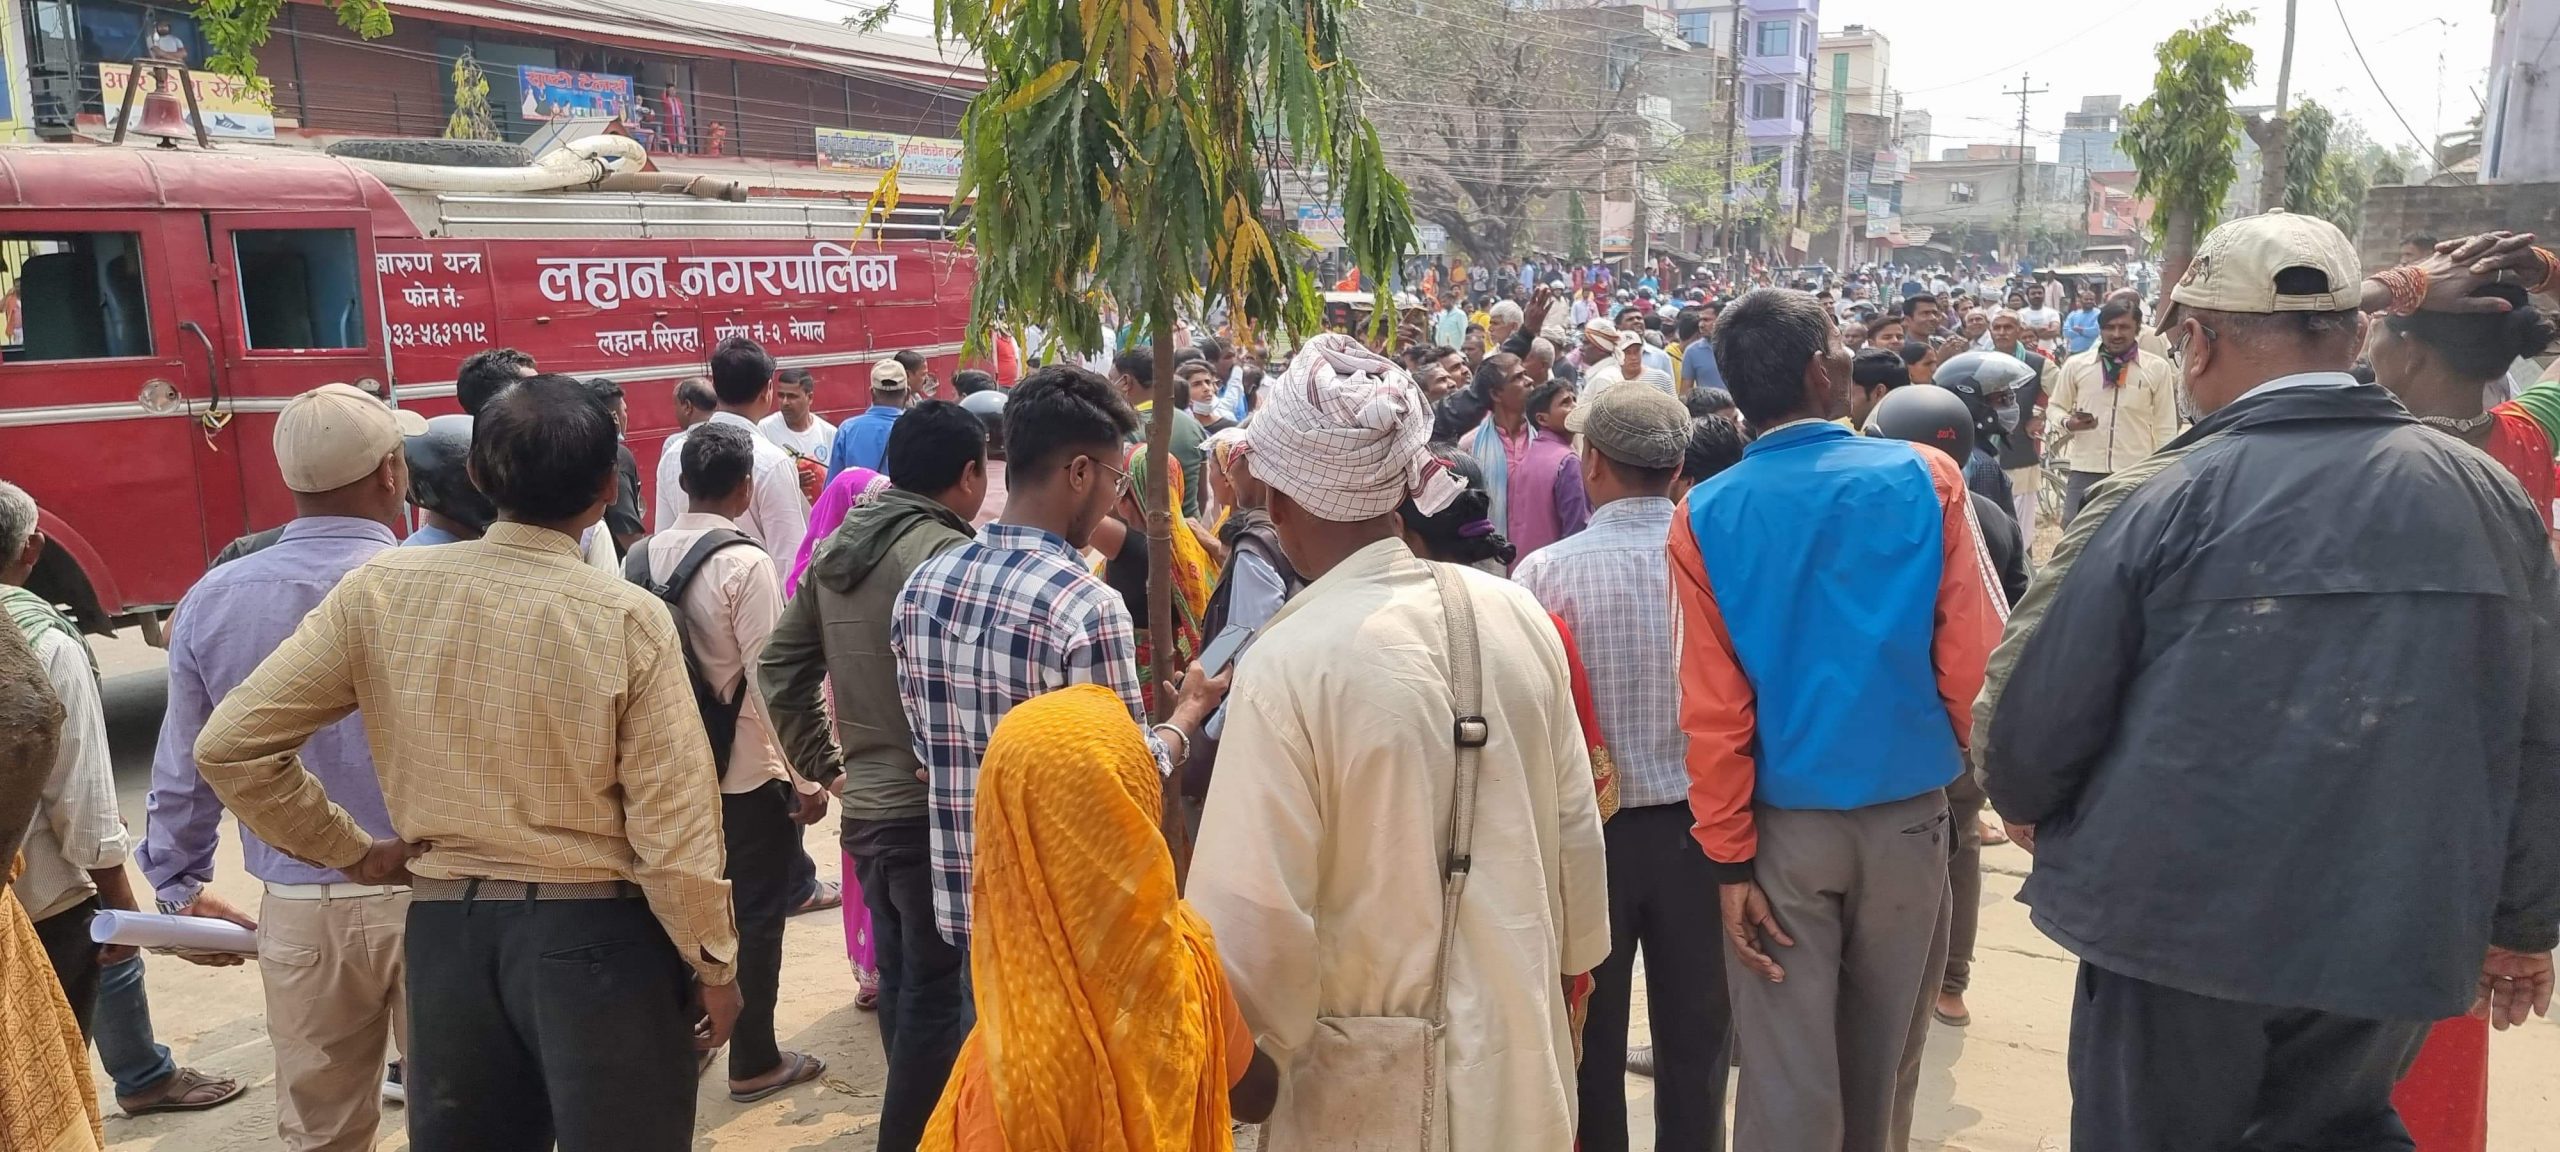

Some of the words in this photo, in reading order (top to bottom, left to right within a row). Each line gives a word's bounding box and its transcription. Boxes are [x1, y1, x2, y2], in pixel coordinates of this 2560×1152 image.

[442, 253, 481, 274] यन्त्र
[537, 257, 667, 309] लहान
[678, 241, 898, 297] नगरपालिका
[402, 281, 439, 308] फोन
[788, 316, 825, 344] नेपाल
